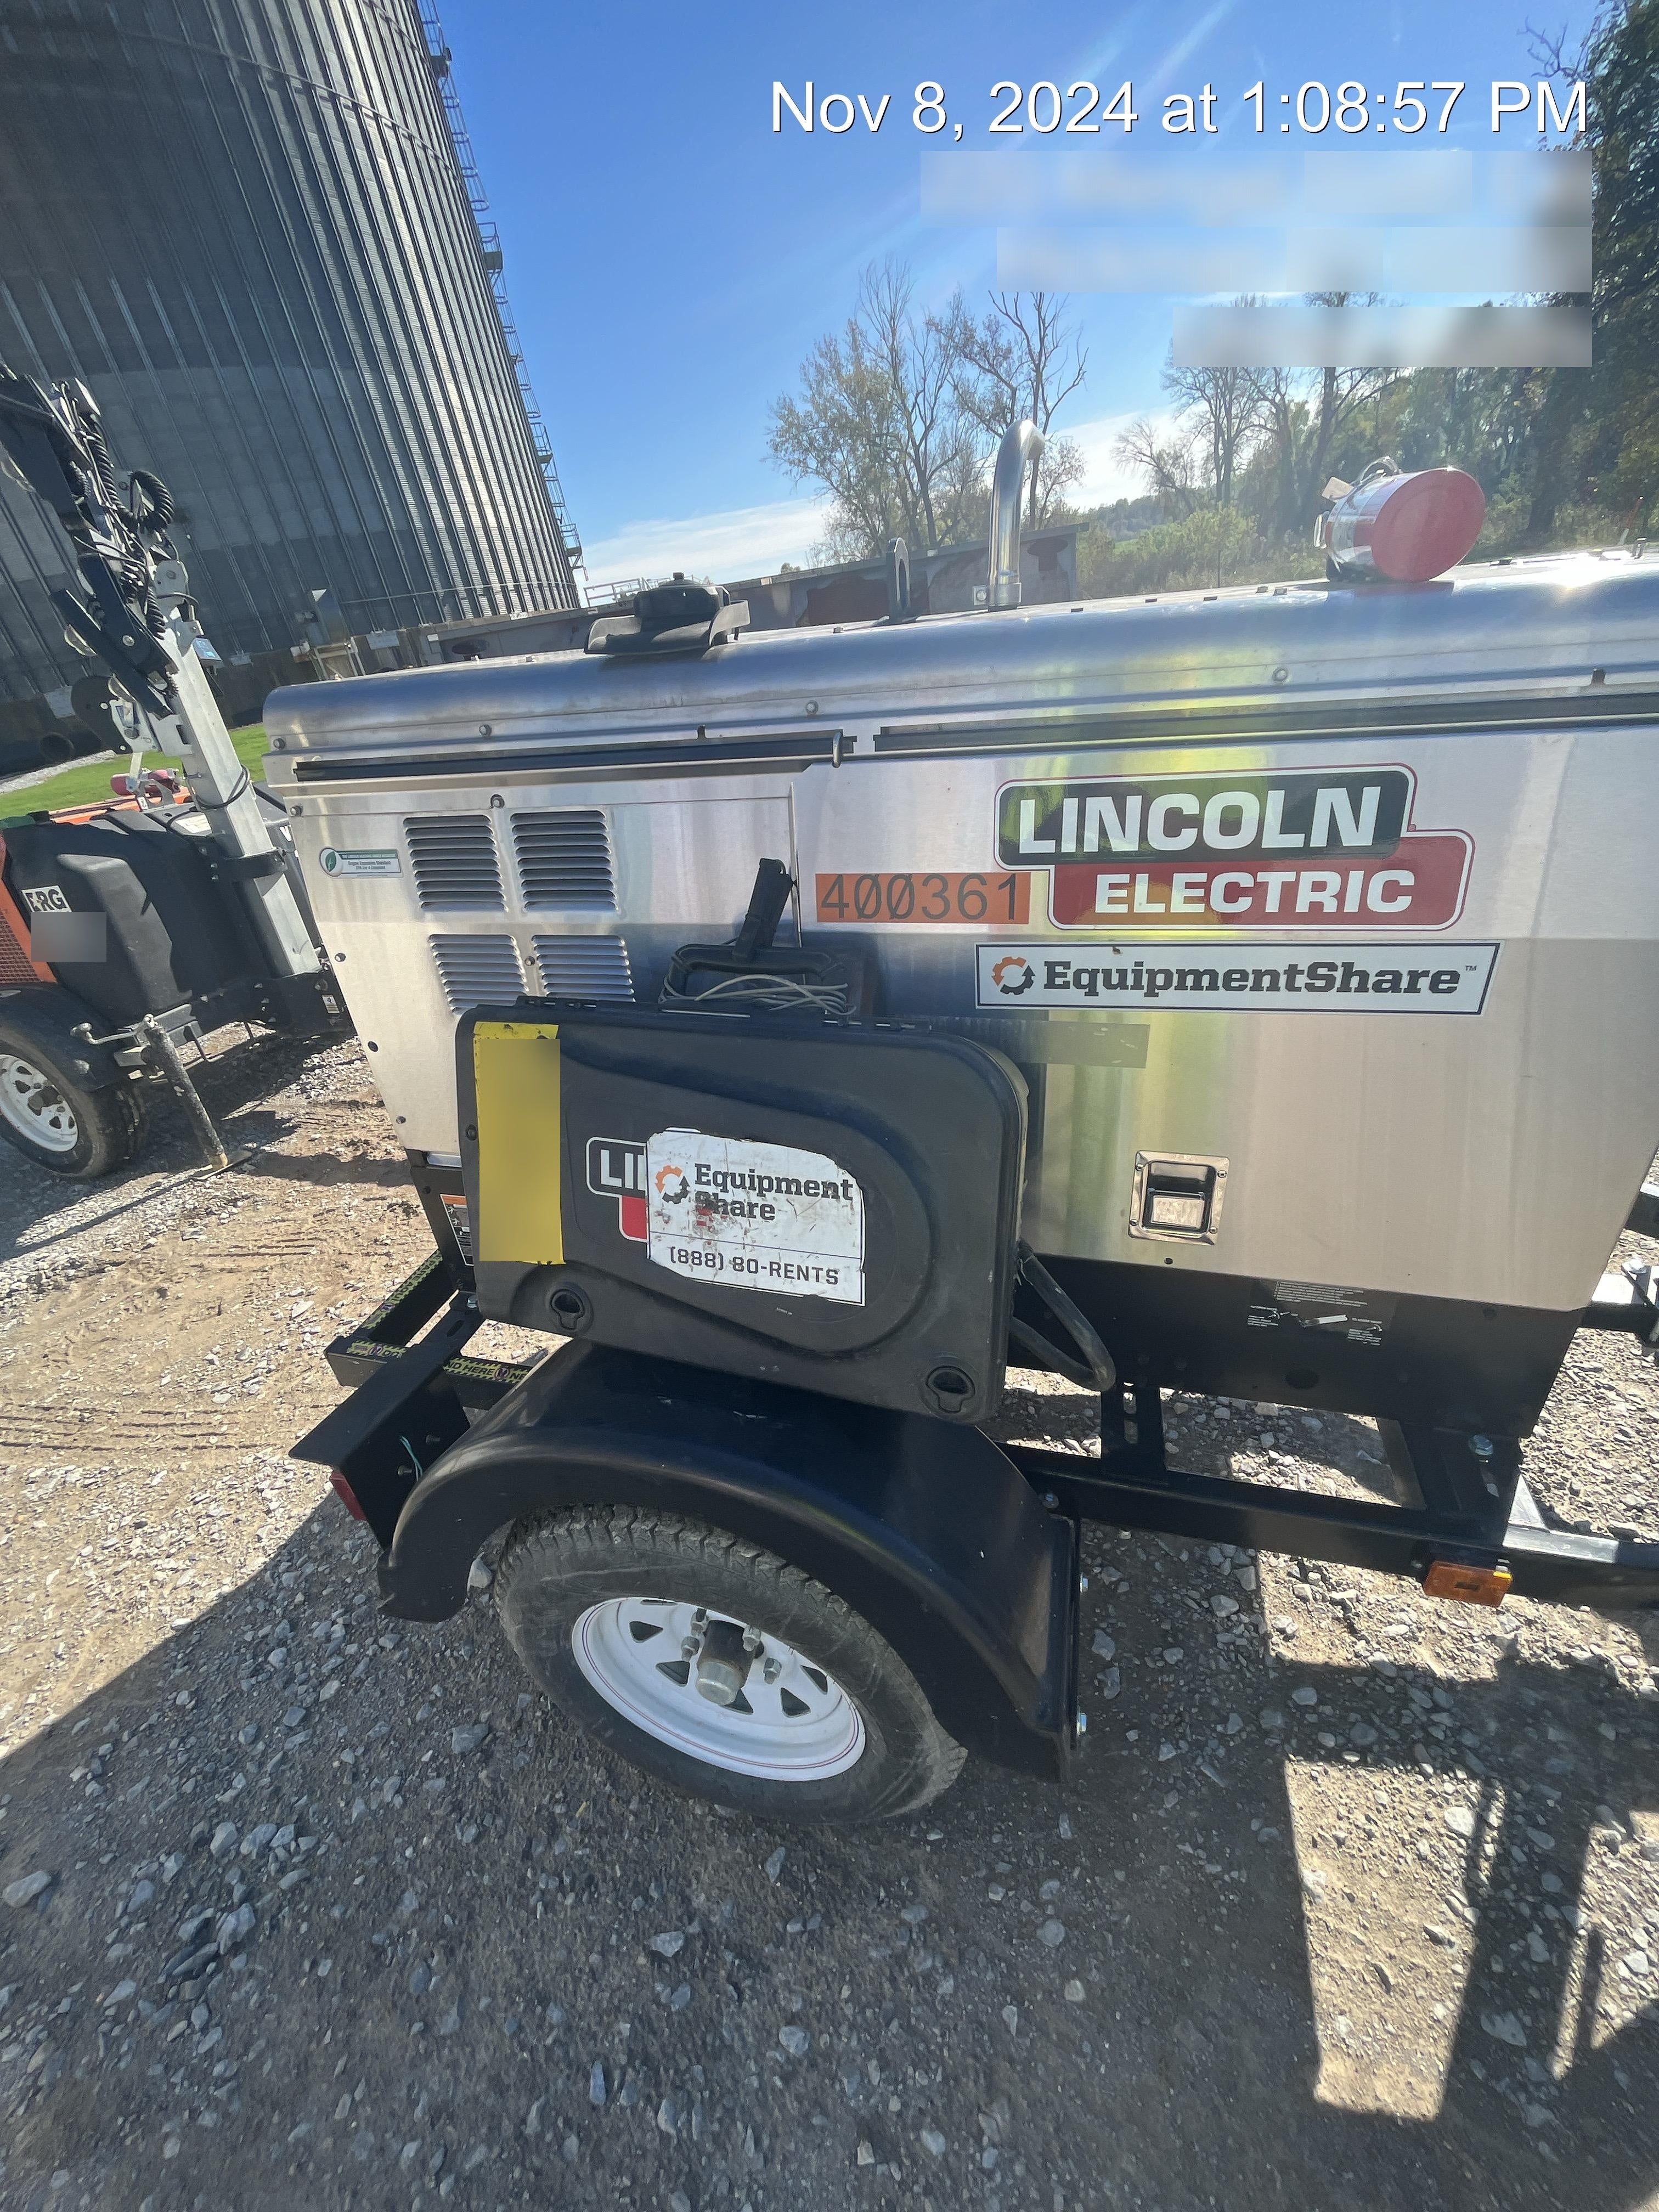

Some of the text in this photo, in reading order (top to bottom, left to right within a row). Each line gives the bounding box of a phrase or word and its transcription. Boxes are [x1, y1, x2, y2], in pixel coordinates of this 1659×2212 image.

[1019, 786, 1381, 854] LINCOLN
[821, 873, 1017, 920] 400361
[1094, 870, 1415, 915] ELECTRIC
[1044, 960, 1461, 997] EquipmentShare
[695, 1163, 853, 1201] Equipment
[695, 1191, 775, 1221] Share
[670, 1246, 839, 1285] (888) 80-RENTS
[463, 1364, 495, 1376] HERE
